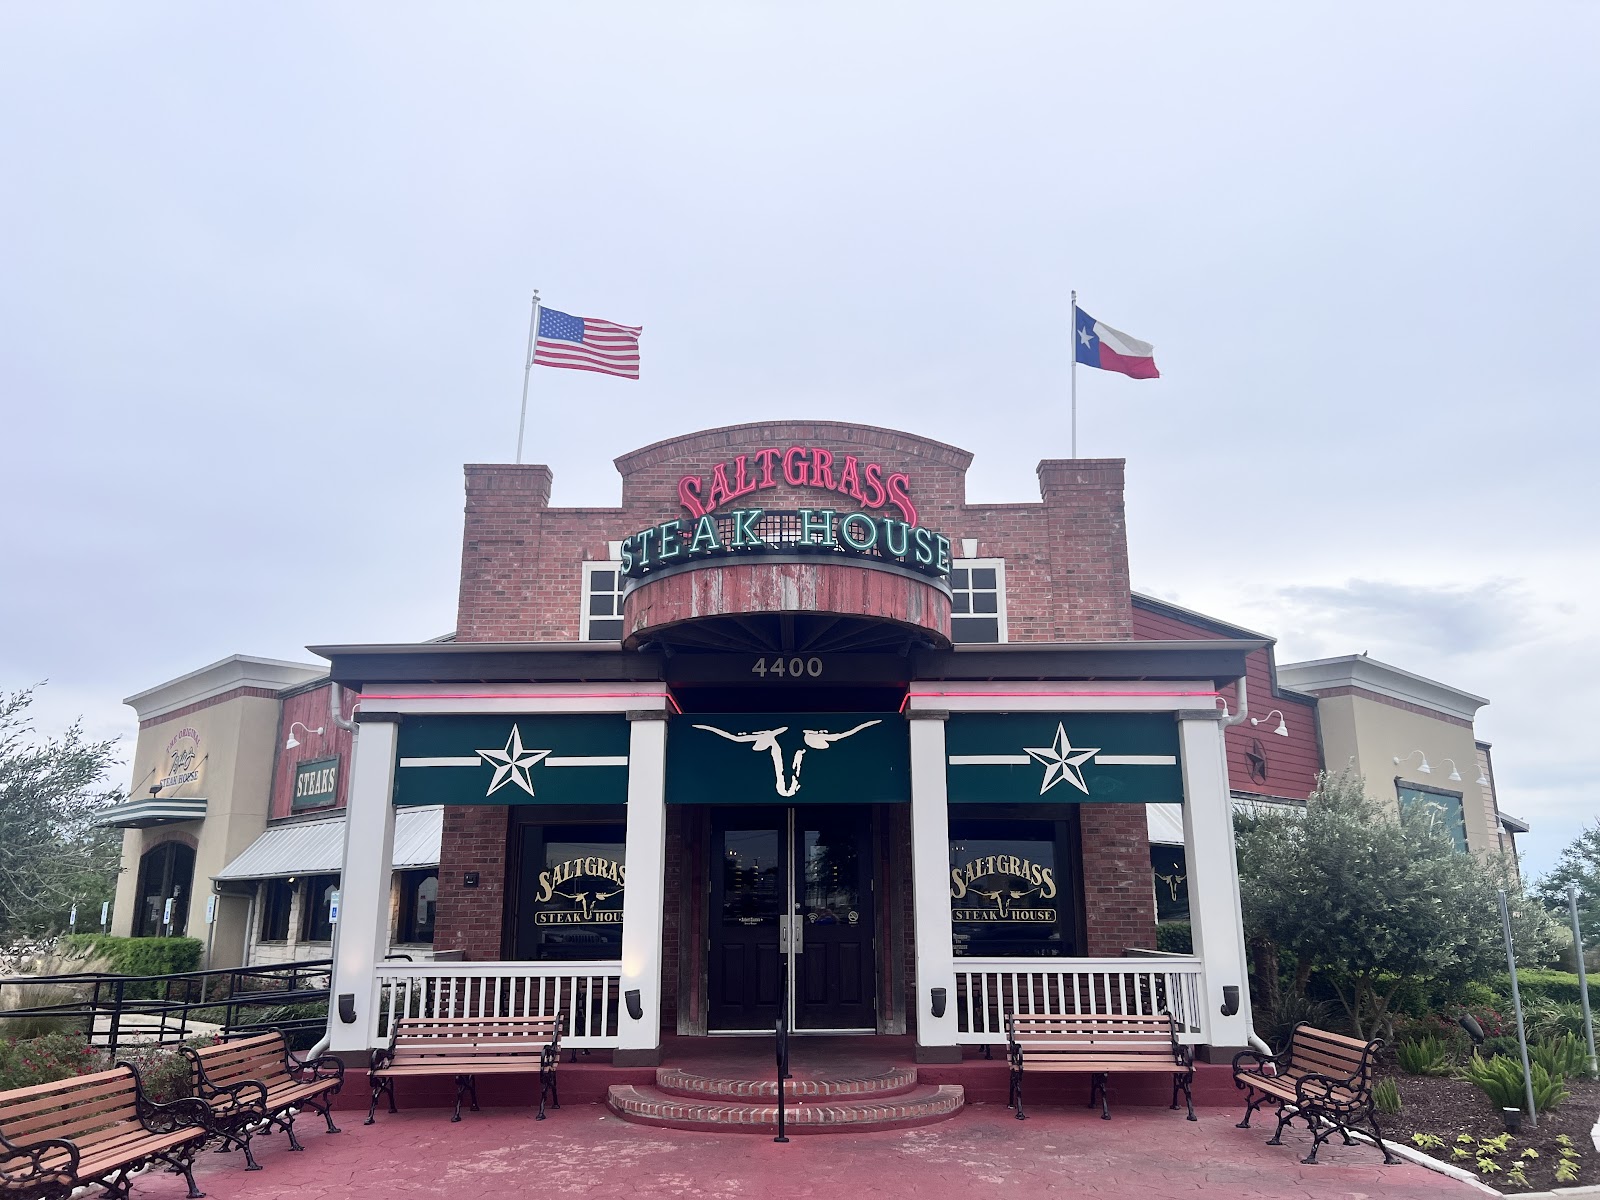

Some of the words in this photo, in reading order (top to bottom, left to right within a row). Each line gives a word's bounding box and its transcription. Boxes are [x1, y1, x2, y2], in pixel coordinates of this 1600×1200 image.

[678, 447, 918, 528] SALTGRASS
[620, 508, 765, 576] STEAK
[797, 508, 951, 574] HOUSE
[752, 657, 823, 677] 4400
[160, 776, 178, 787] STEAK
[178, 771, 198, 784] HOUSE
[297, 768, 335, 797] STEAKS
[535, 857, 625, 902] SALTGRAS
[951, 855, 1056, 898] SALTGRASS
[540, 913, 581, 922] STEAK
[595, 912, 624, 921] HOU
[956, 911, 997, 920] STEAK
[1012, 911, 1052, 920] HOUSE
